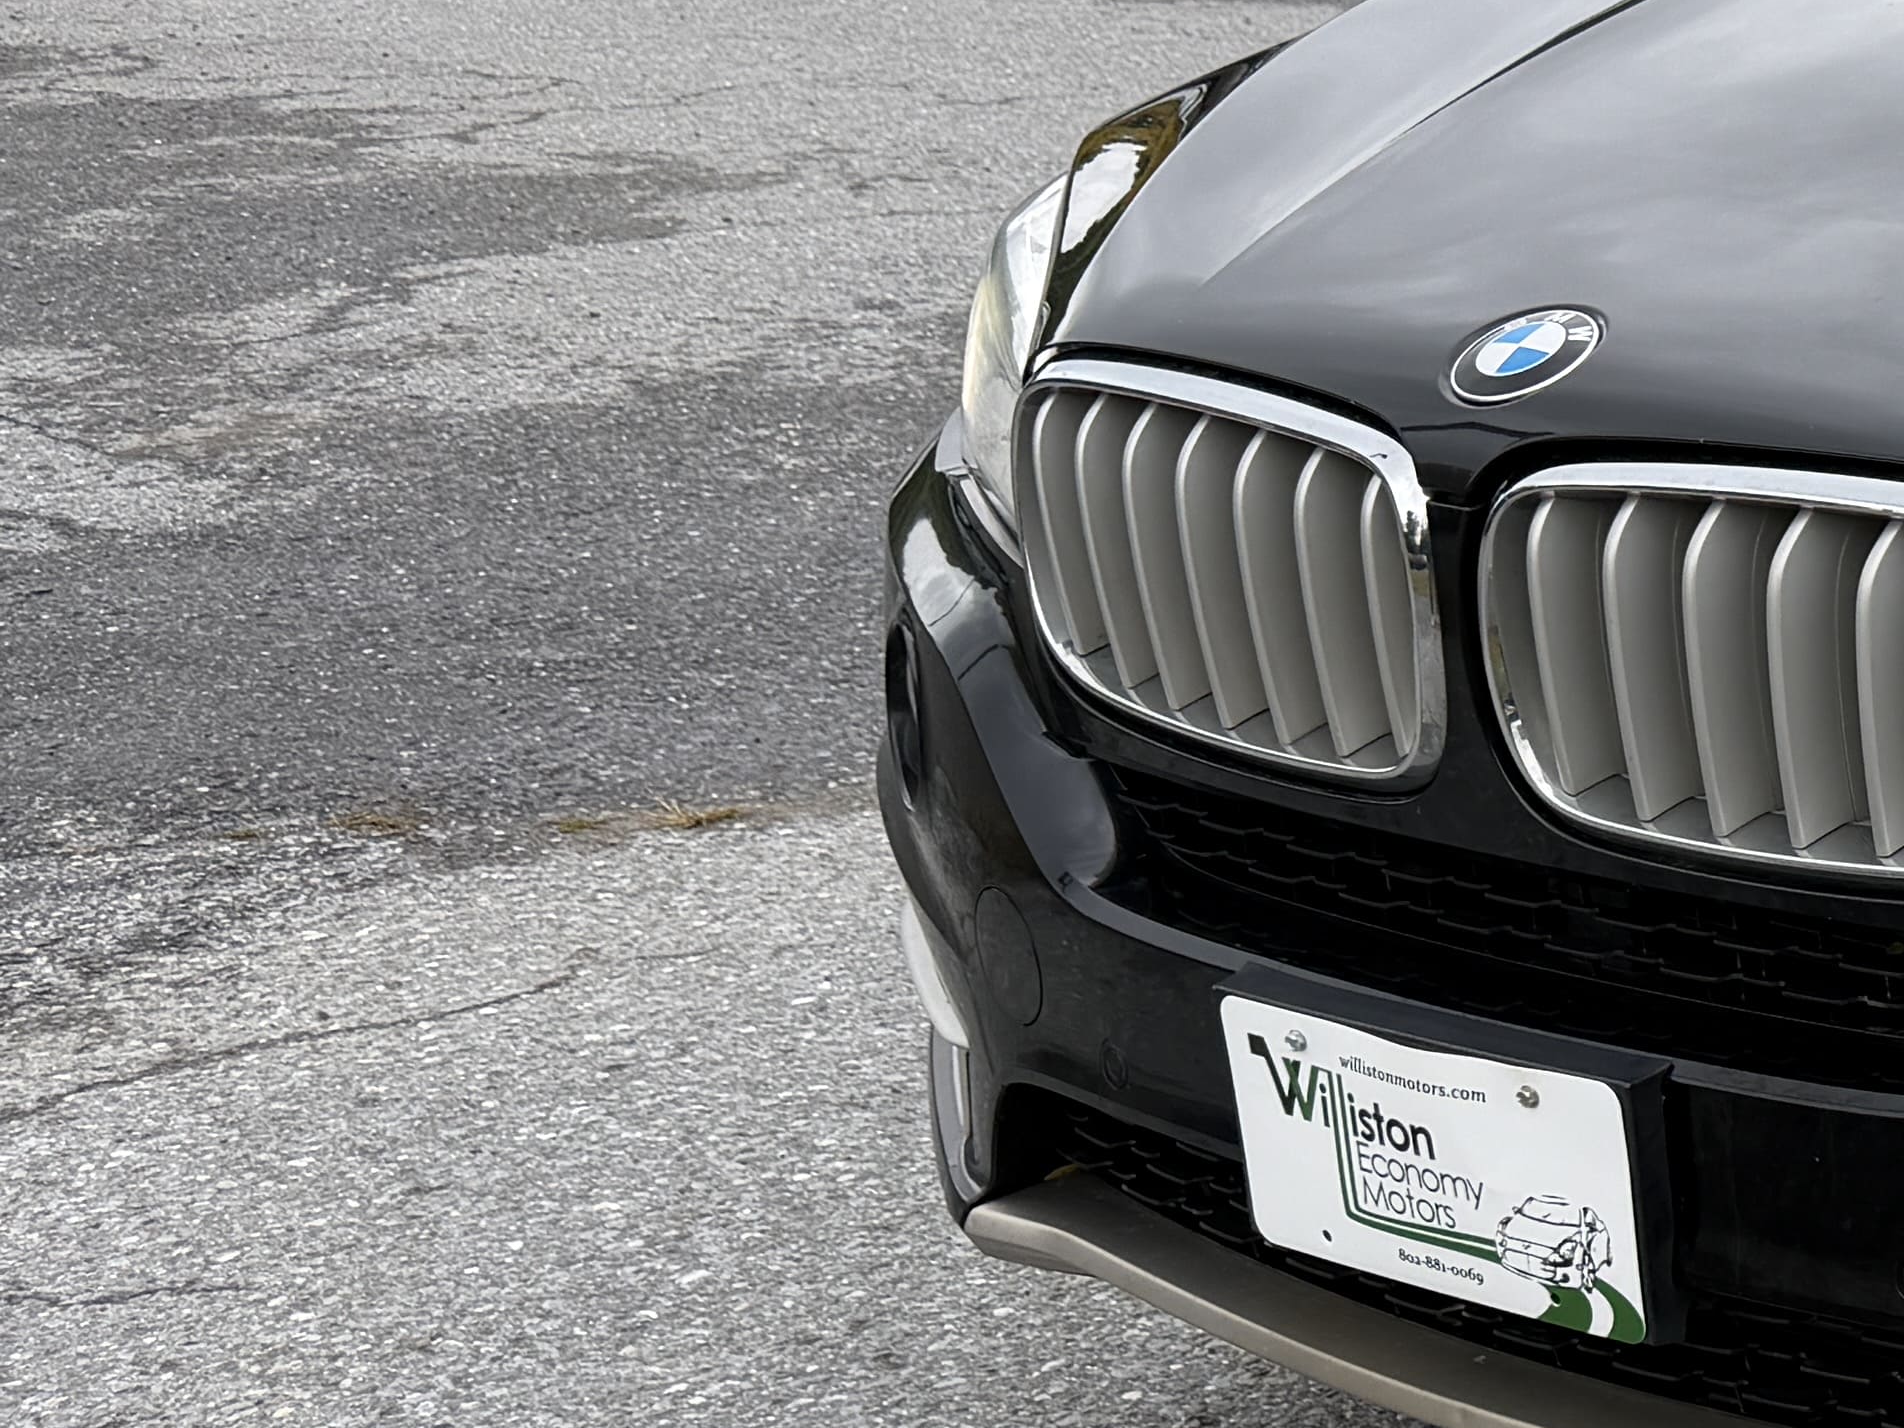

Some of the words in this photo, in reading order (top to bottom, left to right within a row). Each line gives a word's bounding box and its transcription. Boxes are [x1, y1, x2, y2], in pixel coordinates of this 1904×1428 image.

[1246, 1033, 1436, 1161] Williston
[1338, 1055, 1487, 1103] willistonmotors.com
[1357, 1143, 1484, 1211] Economy
[1363, 1178, 1457, 1229] Motors
[1398, 1247, 1485, 1286] 802-881-0069
